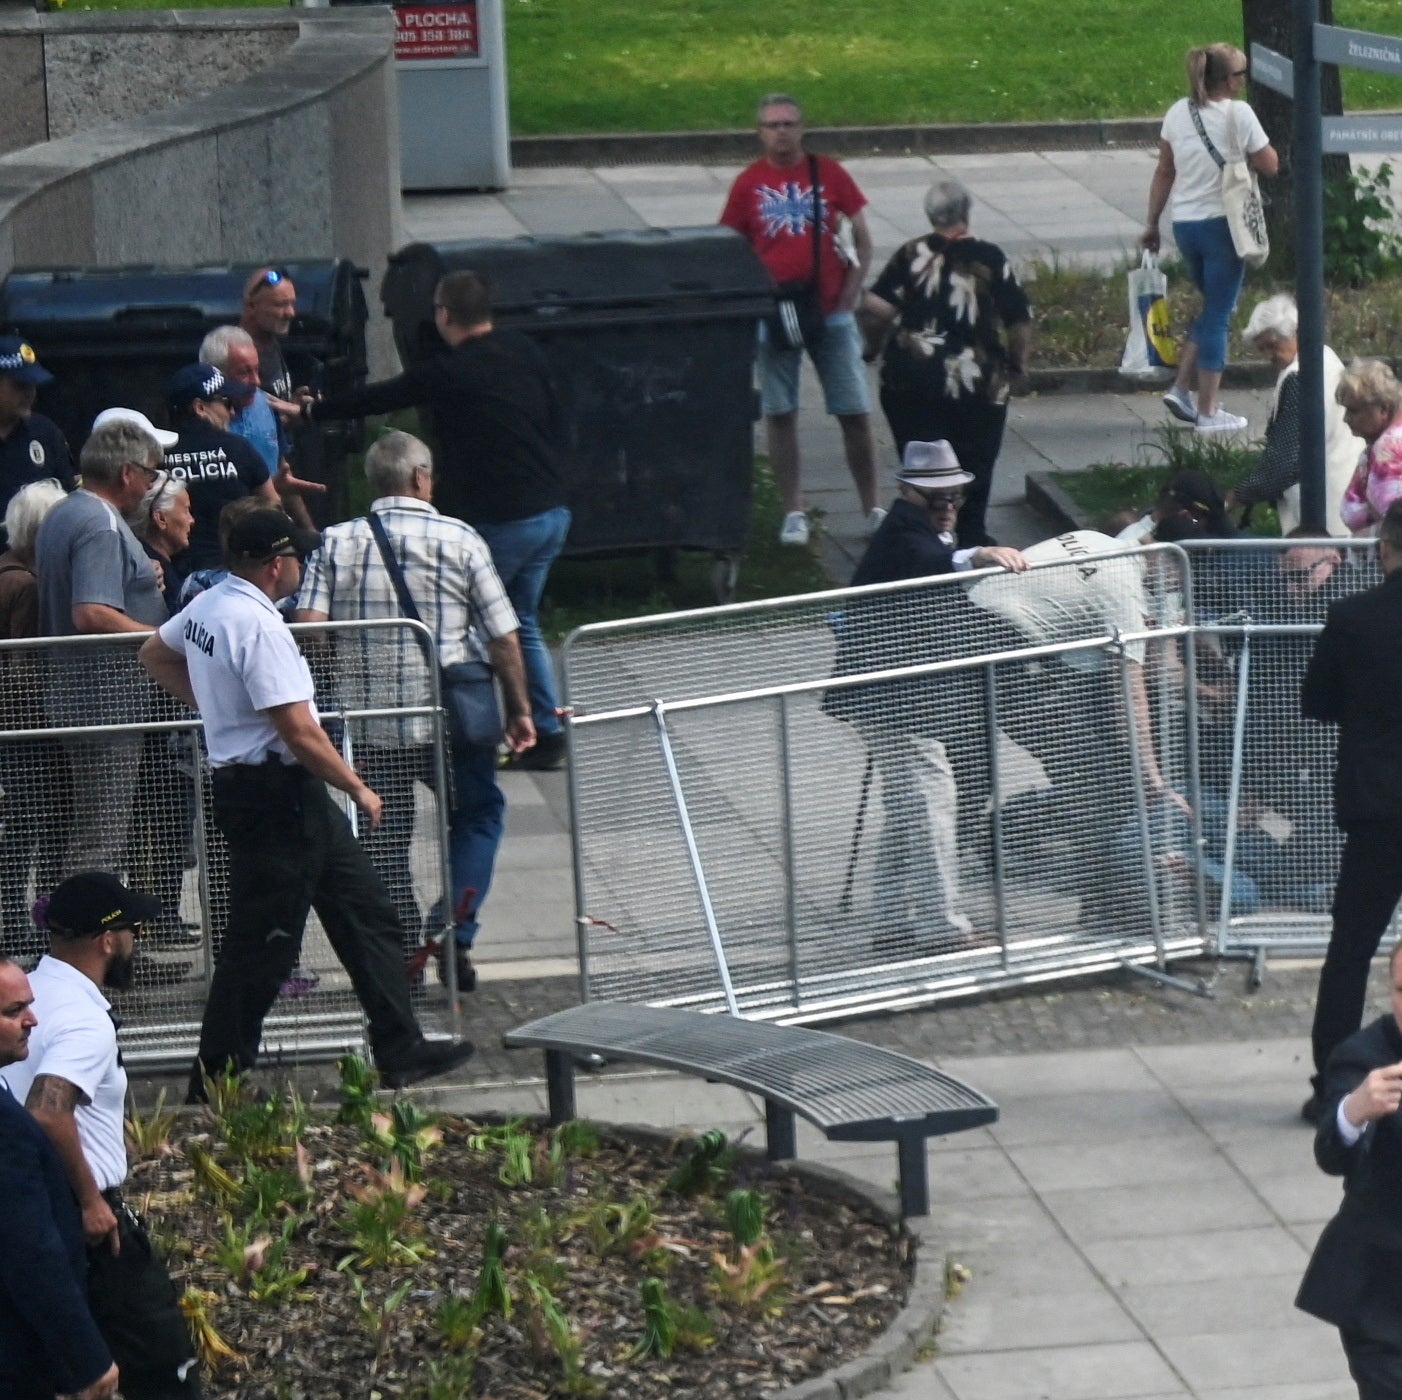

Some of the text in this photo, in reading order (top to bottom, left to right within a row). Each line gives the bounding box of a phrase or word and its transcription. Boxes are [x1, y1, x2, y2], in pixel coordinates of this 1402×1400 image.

[404, 12, 471, 27] PLOCHA
[1348, 40, 1400, 62] ŽELEZNIČNÁ
[165, 447, 227, 464] MESTSKÁ
